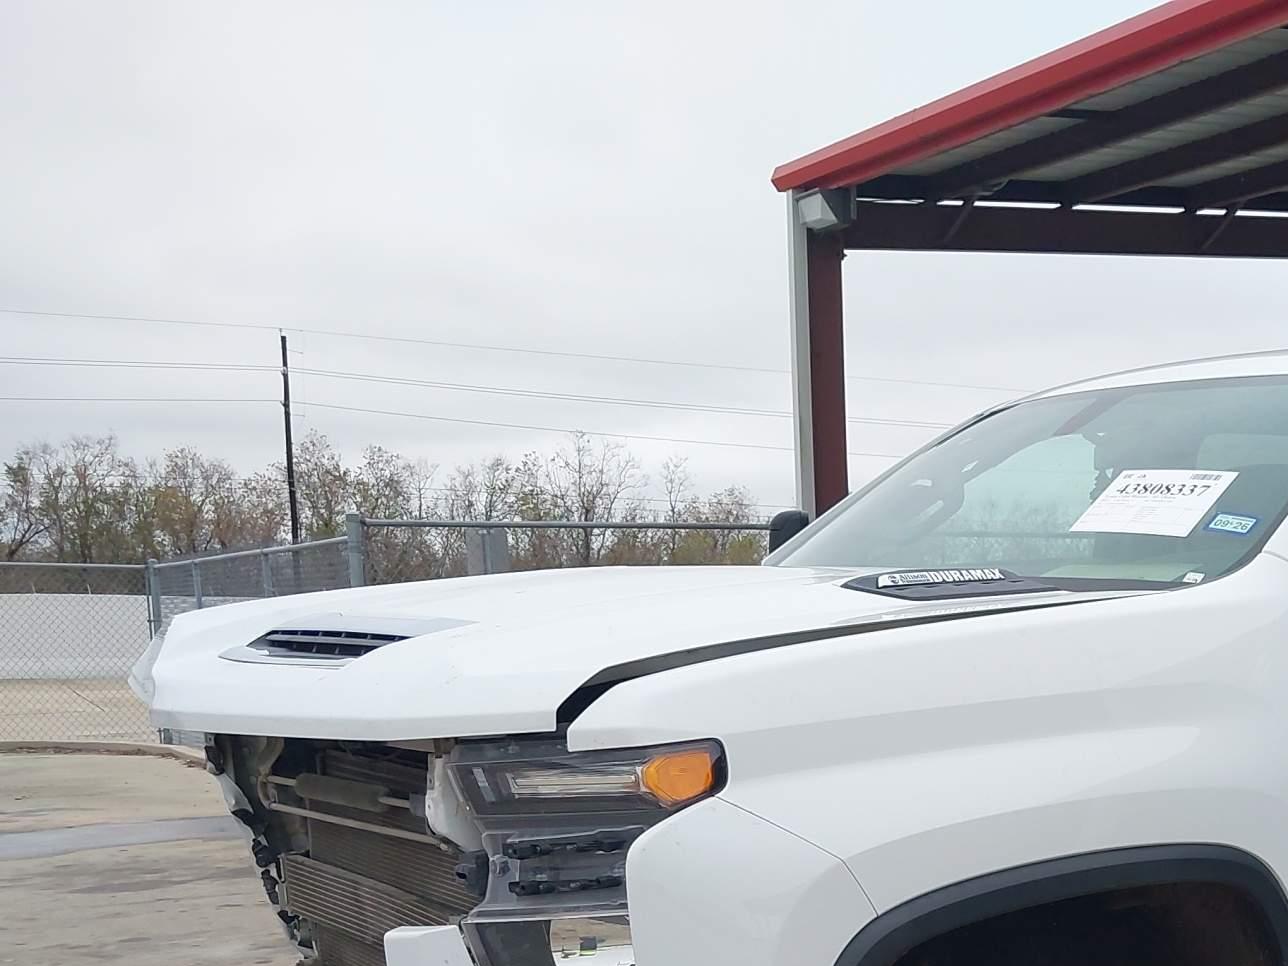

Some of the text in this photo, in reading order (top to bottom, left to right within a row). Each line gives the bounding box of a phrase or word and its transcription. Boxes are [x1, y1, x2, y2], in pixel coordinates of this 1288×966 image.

[1116, 483, 1211, 497] 43808337
[1214, 519, 1251, 531] 09 26
[929, 568, 1005, 583] DURAMAX
